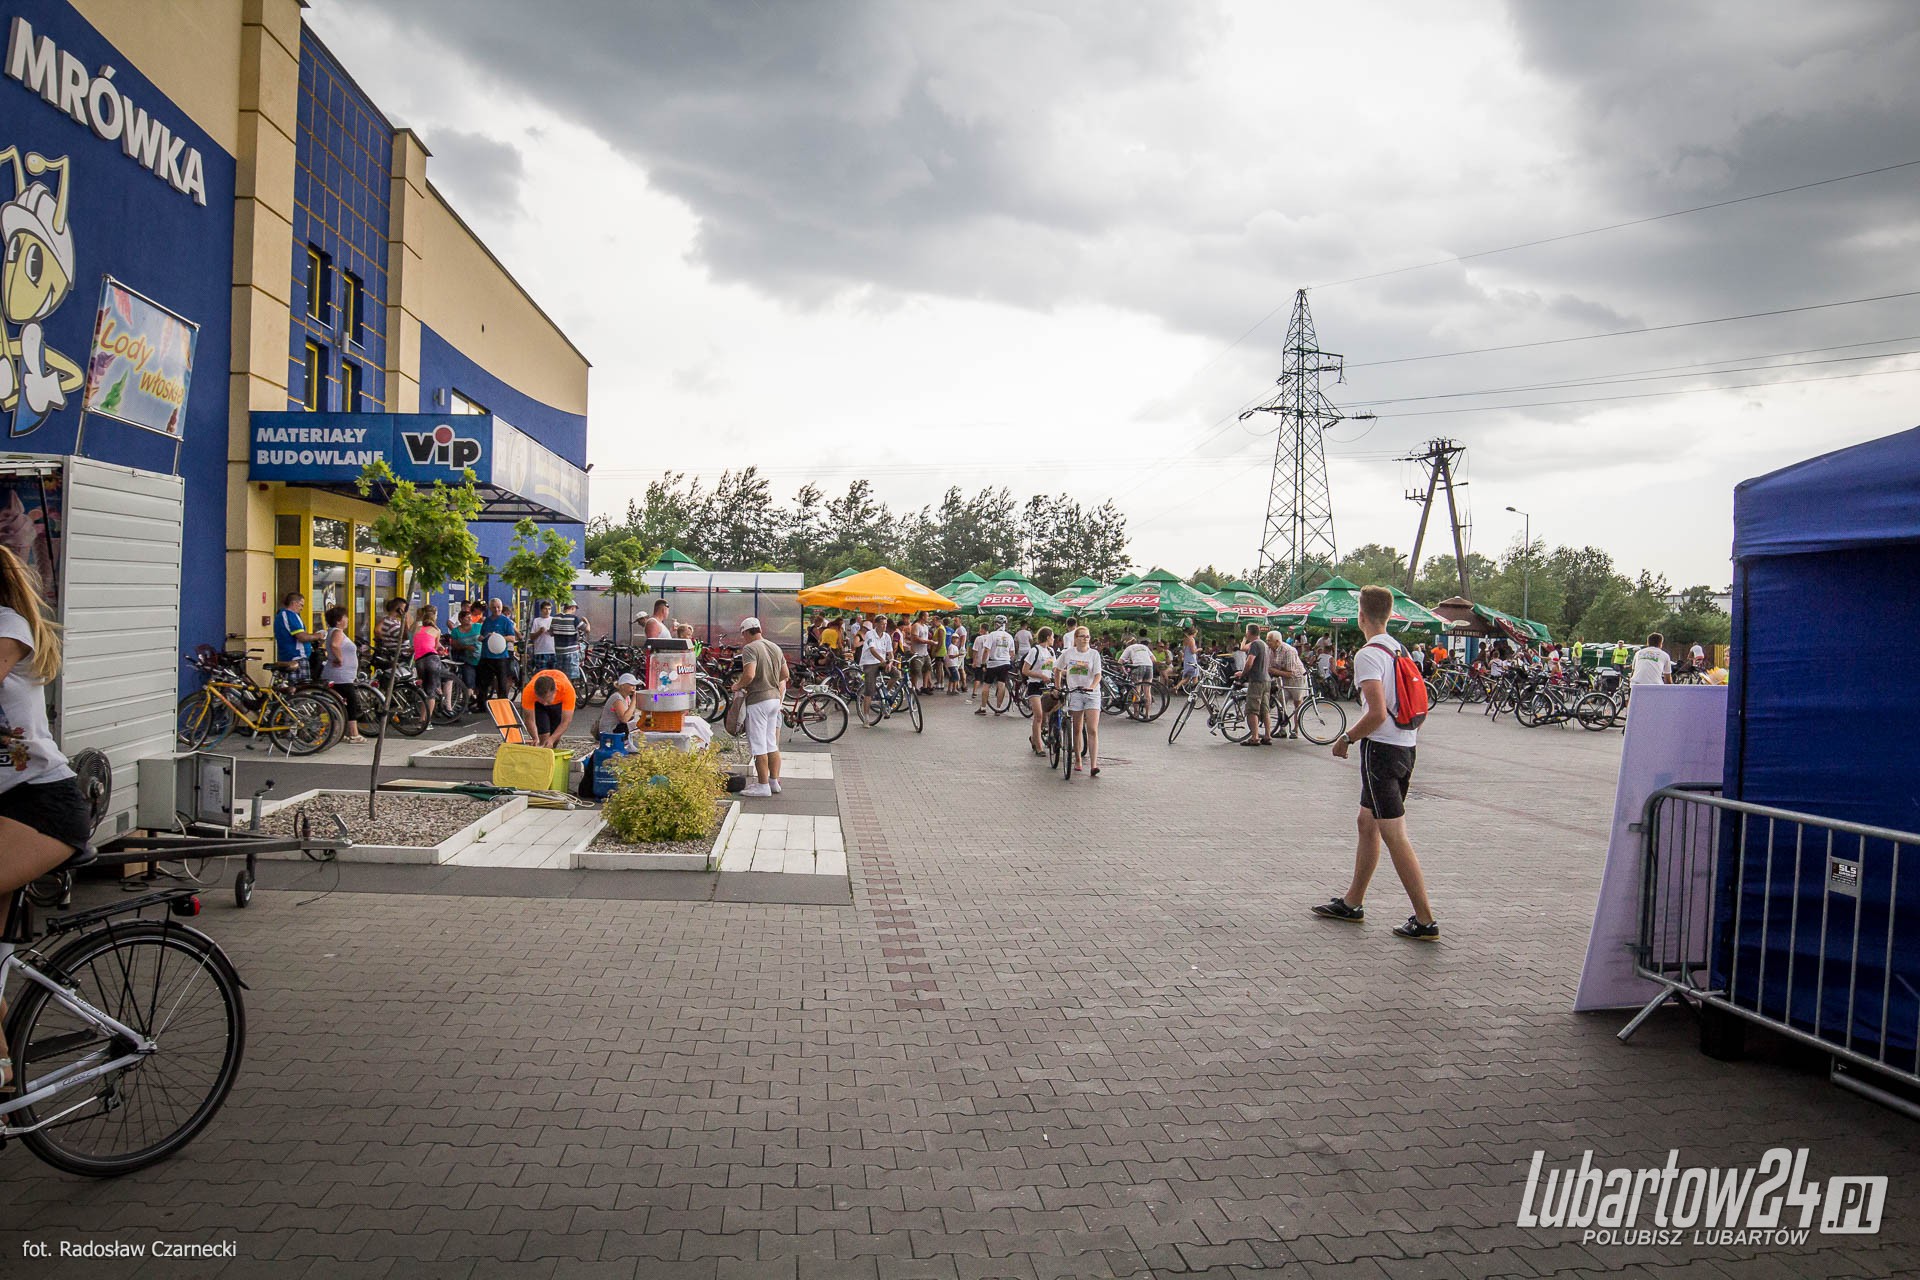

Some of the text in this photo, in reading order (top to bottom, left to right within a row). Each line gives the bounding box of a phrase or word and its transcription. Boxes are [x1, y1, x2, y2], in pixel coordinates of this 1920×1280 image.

[4, 16, 207, 207] MRÓWKA
[100, 320, 154, 372] Lody
[140, 369, 184, 405] włoskie
[256, 428, 367, 443] MATERIAŁY
[983, 596, 1031, 605] PERŁA
[1838, 864, 1857, 875] SLS
